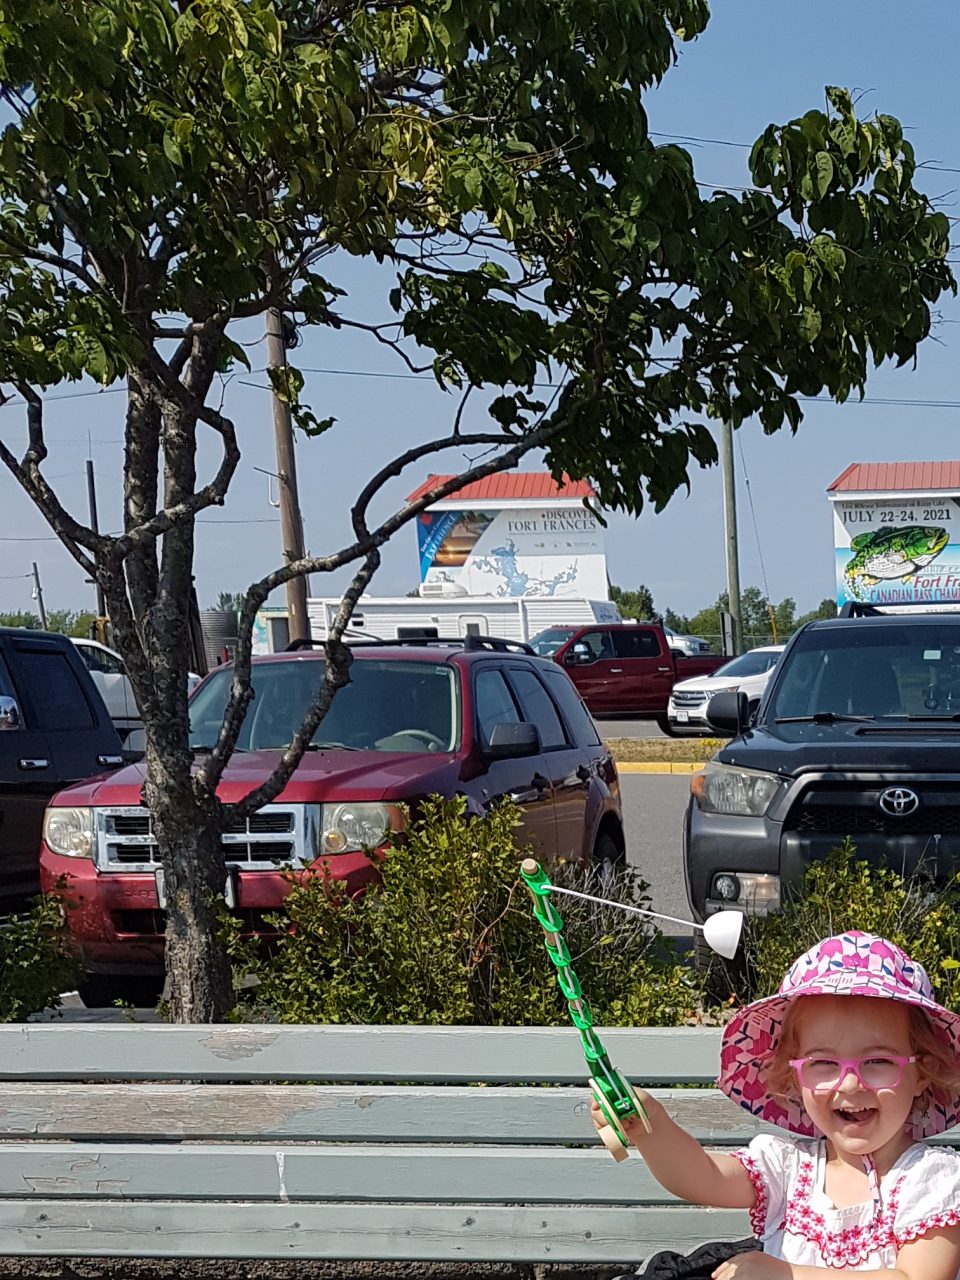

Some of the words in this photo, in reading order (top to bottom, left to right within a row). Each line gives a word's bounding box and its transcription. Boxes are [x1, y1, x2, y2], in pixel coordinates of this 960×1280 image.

[842, 510, 875, 524] JULY
[880, 510, 918, 522] 22-24,
[923, 509, 952, 521] 2021
[508, 521, 537, 531] FORT
[543, 519, 596, 531] FRANCES
[425, 512, 457, 560] EXPERIENCE
[913, 577, 940, 588] Fort
[870, 589, 912, 603] CANADIAN
[914, 588, 933, 602] BASS
